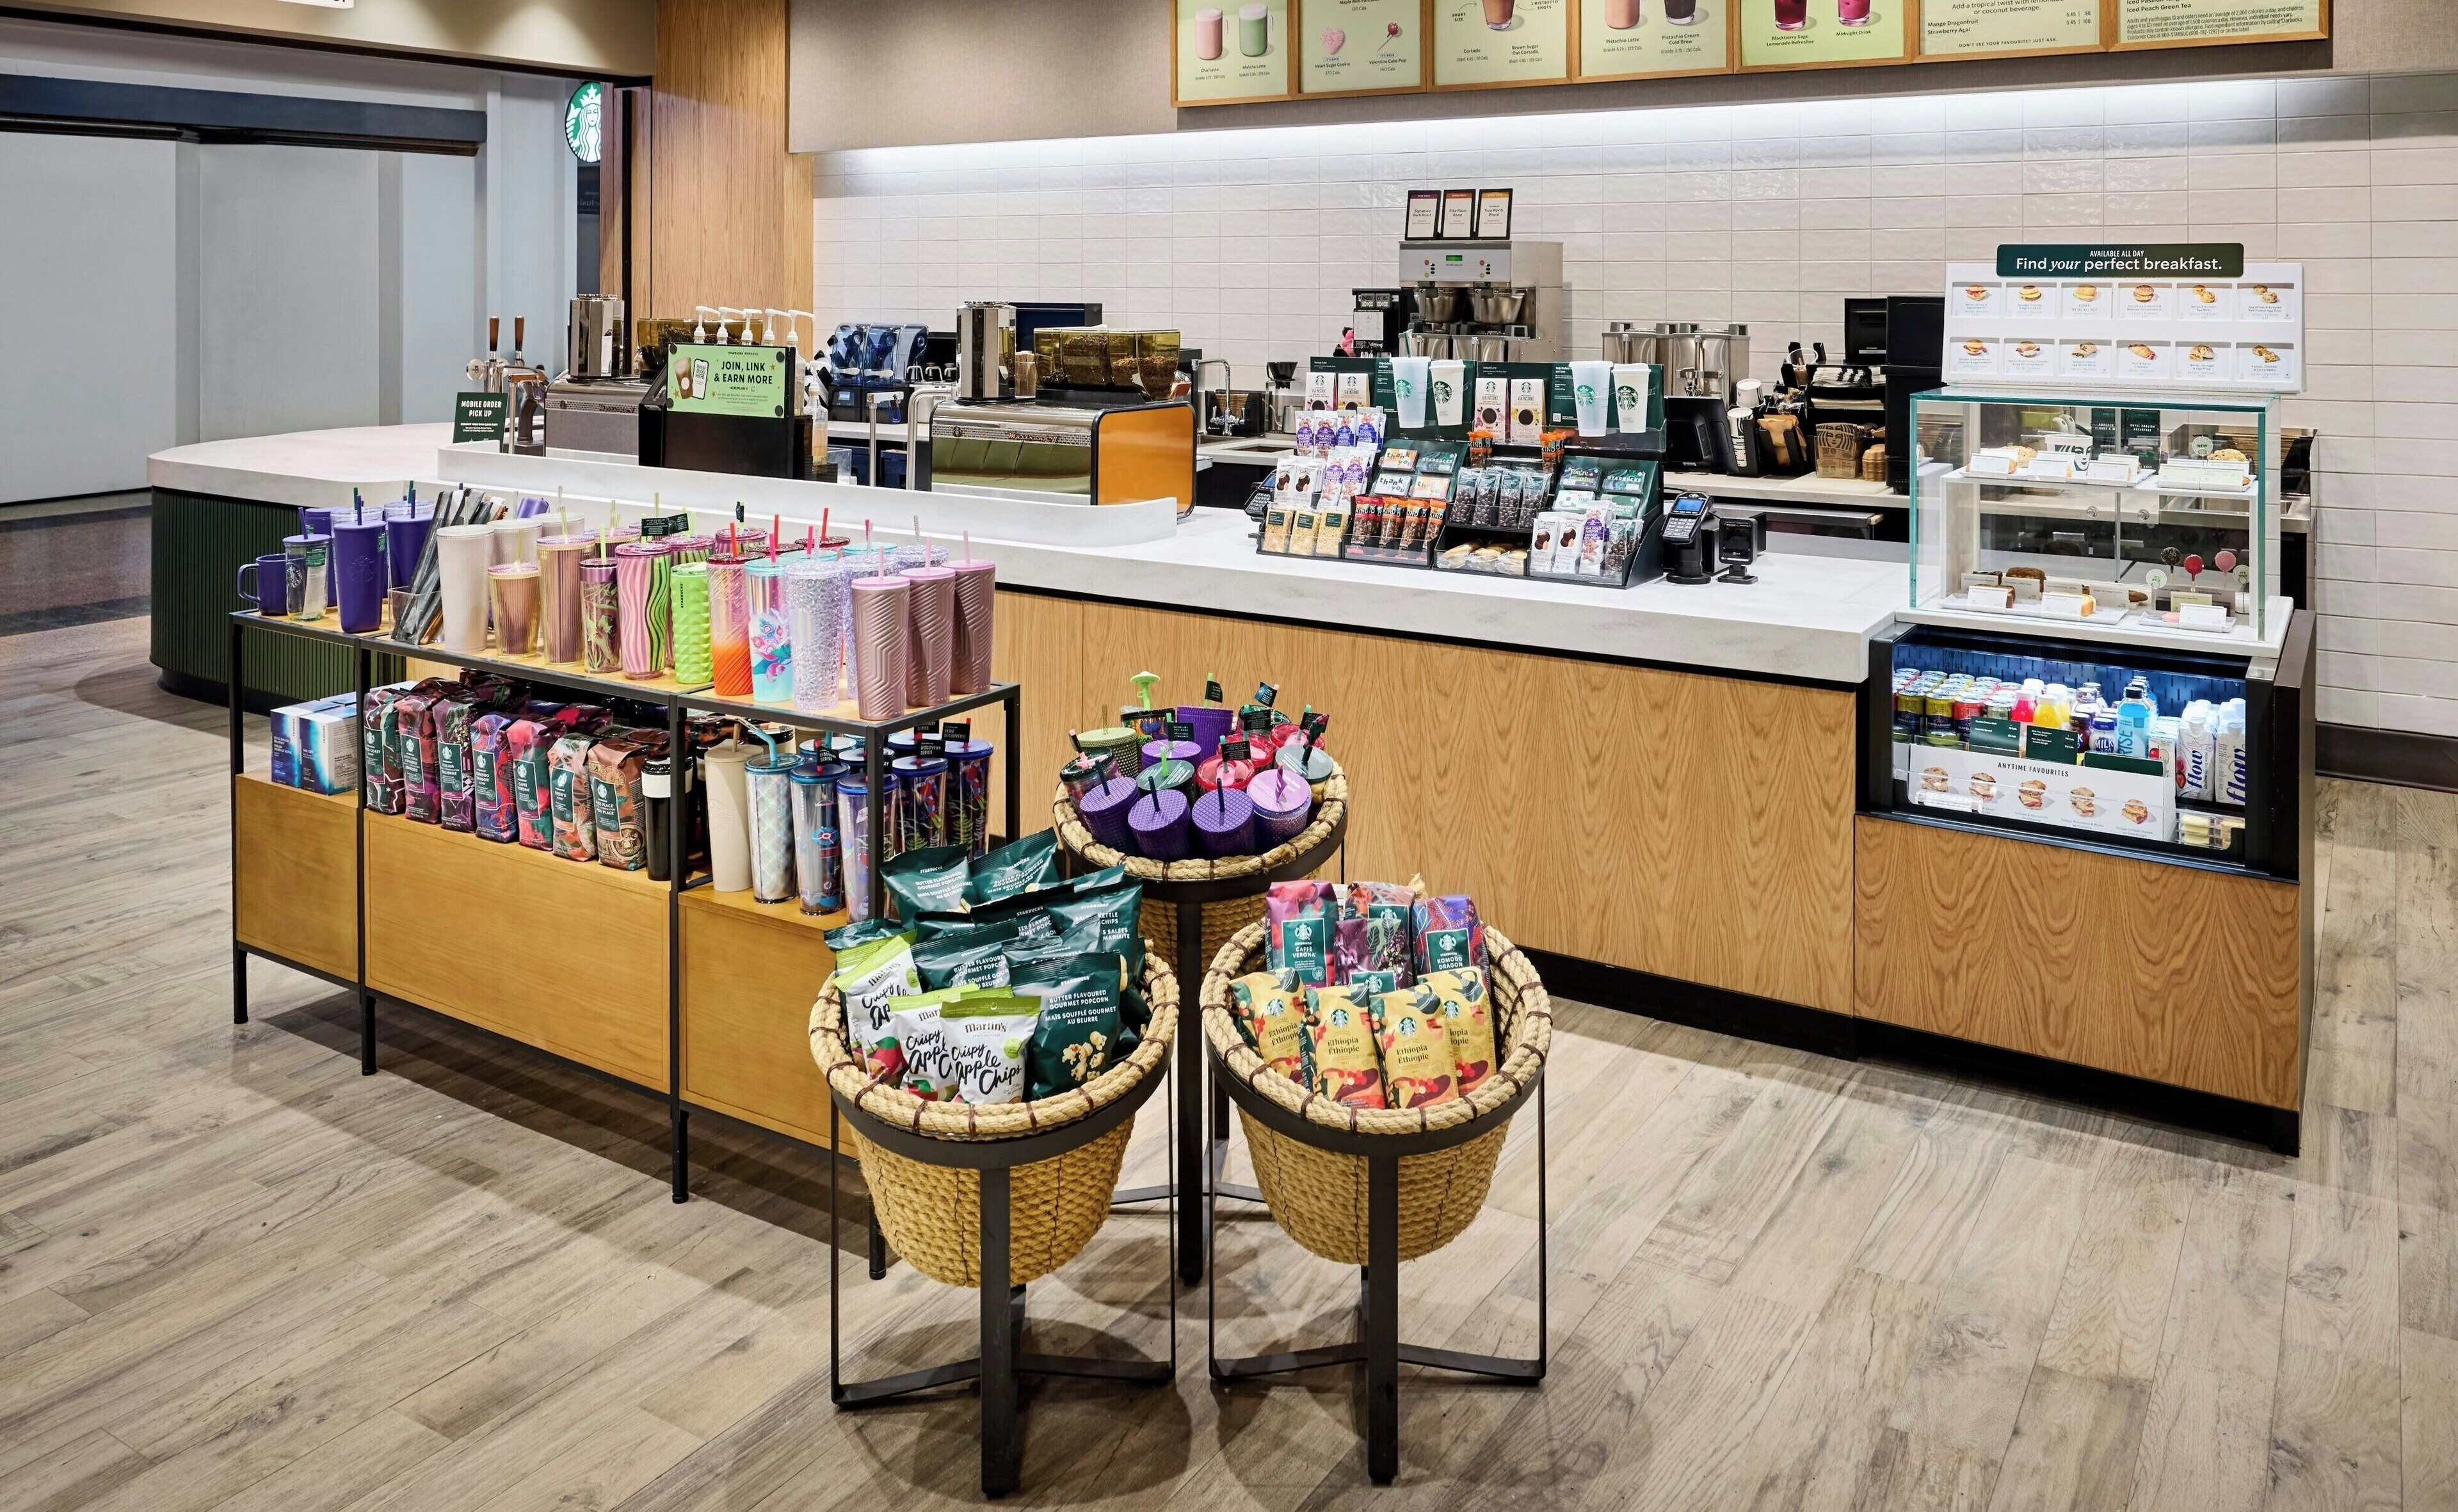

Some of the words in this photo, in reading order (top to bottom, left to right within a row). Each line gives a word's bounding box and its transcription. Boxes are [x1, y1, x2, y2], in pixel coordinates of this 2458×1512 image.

[2016, 257, 2047, 269] Find
[2048, 260, 2081, 271] your
[2084, 257, 2140, 272] perfect
[2144, 257, 2222, 269] breakfast.
[721, 361, 743, 372] JOIN,
[746, 362, 765, 371] LINK
[714, 373, 719, 382] &
[723, 374, 744, 383] EARN
[748, 375, 773, 384] MORE
[2094, 736, 2114, 752] MILK
[1998, 762, 2027, 772] ANYTIME
[2029, 765, 2069, 777] FAVOURITES
[2187, 750, 2203, 789] flow
[1006, 857, 1030, 871] STARBUCKS
[933, 871, 961, 883] FLAVOURED
[942, 875, 966, 885] POPCORN
[951, 881, 973, 890] GOURMET
[944, 889, 963, 897] BEURRE
[1016, 905, 1043, 917] STARBUCKS
[955, 965, 983, 979] GOURMET
[968, 972, 991, 983] SOUFFLÉ
[982, 977, 1004, 988] BEURRE
[1061, 976, 1089, 986] STARBUCKS
[862, 982, 896, 1009] Crispy
[1050, 994, 1072, 1004] BUTTER
[1073, 990, 1106, 999] FLAVOURED
[1050, 1000, 1079, 1010] GOURMET
[1080, 997, 1109, 1005] POPCORN
[1063, 1009, 1086, 1018] SOUFFLÉ
[1088, 1006, 1116, 1015] GOURMET
[965, 1022, 1007, 1033] martin's
[1269, 1023, 1297, 1038] Ethiopia
[906, 1030, 943, 1050] Crispy
[1328, 1036, 1359, 1047] Ethiopia
[951, 1043, 988, 1061] Crispy
[1328, 1045, 1360, 1055] Éthiopie
[1396, 1044, 1427, 1056] Ethiopia
[1397, 1052, 1429, 1064] Éthiopie
[979, 1065, 1022, 1095] Chips
